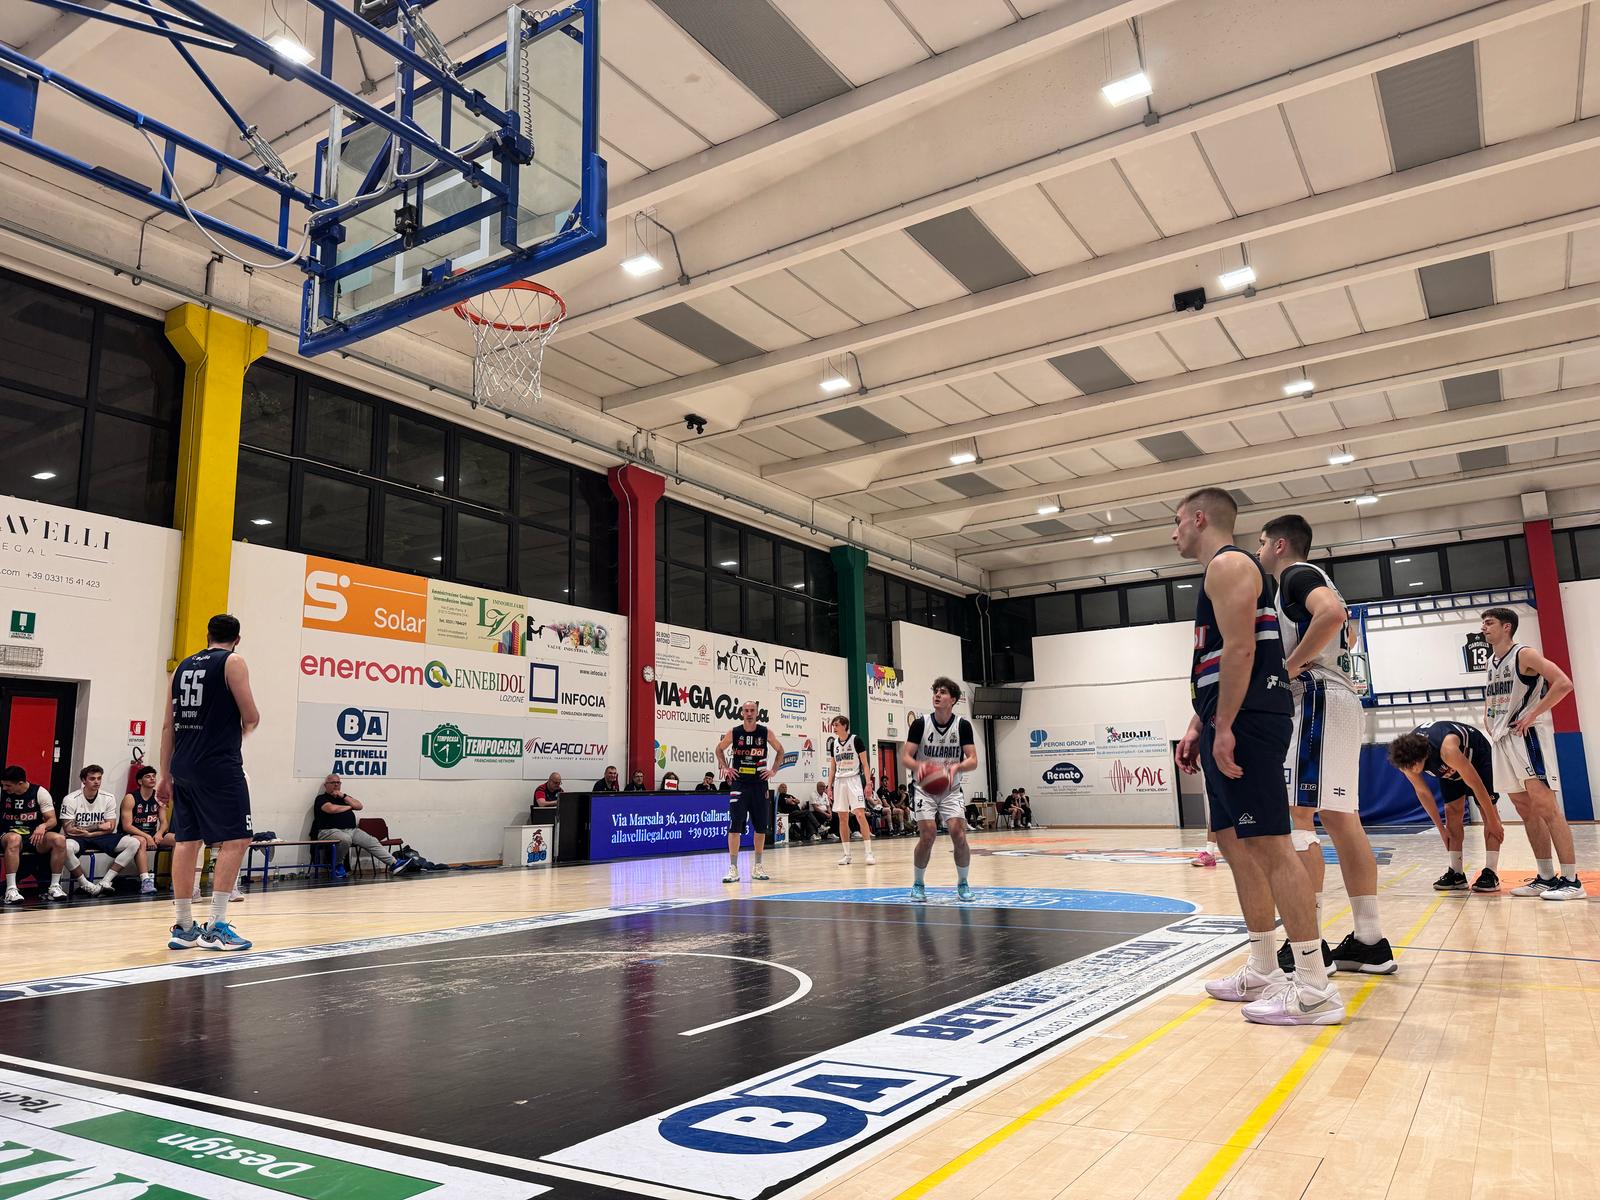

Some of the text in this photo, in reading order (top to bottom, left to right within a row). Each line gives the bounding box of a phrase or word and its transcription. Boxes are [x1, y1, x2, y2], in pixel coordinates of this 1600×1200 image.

[25, 571, 43, 581] +39
[45, 573, 63, 583] 0331
[66, 577, 74, 585] 15
[76, 578, 84, 586] 41
[86, 580, 101, 589] 423
[373, 607, 426, 633] Solar
[1472, 648, 1488, 665] 13
[180, 669, 207, 707] 55
[454, 668, 525, 694] ENNEBIDOL
[499, 694, 525, 704] LOZIONE
[561, 692, 606, 708] INFOCIA
[783, 697, 805, 708] ISEF
[656, 710, 710, 723] SPORTCULTURE
[746, 735, 754, 745] 81
[927, 732, 934, 743] 4
[1122, 731, 1151, 739] RO.DI
[334, 749, 387, 759] BETTINELLI
[466, 739, 521, 755] TEMPOCASA
[533, 742, 609, 755] NEARCO LTW
[670, 745, 715, 764] Renexia
[331, 760, 387, 776] ACCIAI
[1046, 771, 1081, 780] Renato
[1300, 783, 1317, 791] BBG
[14, 799, 25, 810] 22
[611, 809, 731, 827] Via Marsala 36, 21013 Gallarat
[611, 828, 682, 844] allavellilegal.com
[688, 826, 702, 839] +39
[703, 826, 719, 838] 0331
[720, 825, 728, 836] 15
[688, 1072, 920, 1143] BA
[156, 1132, 315, 1179] Design
